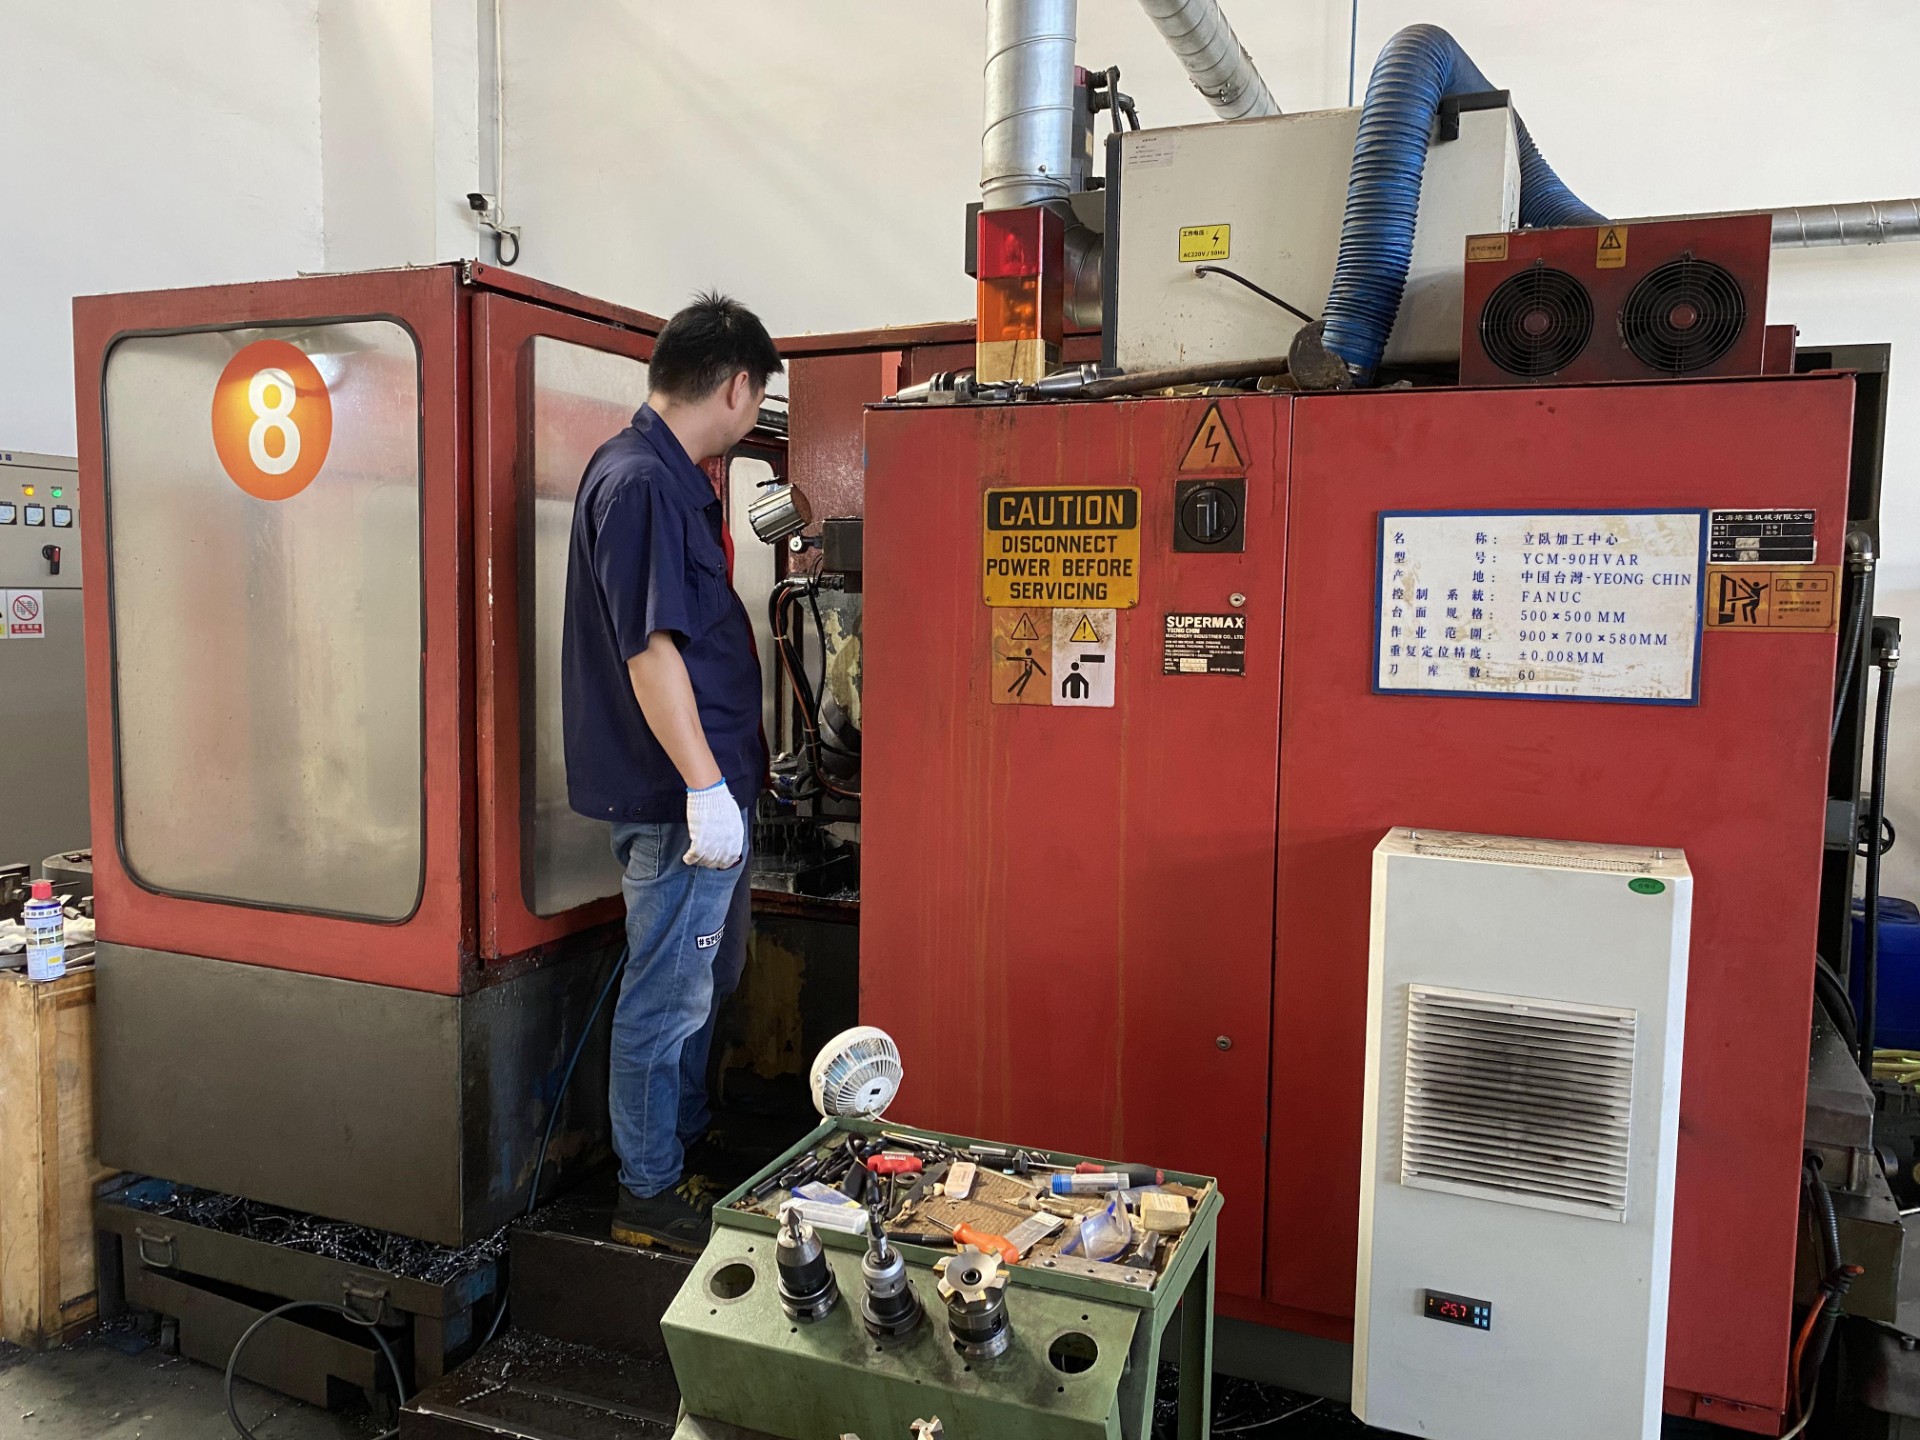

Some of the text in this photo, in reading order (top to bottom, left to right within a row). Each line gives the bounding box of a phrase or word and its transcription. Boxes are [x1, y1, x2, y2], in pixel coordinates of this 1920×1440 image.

[248, 367, 301, 475] 8
[999, 495, 1124, 526] CAUTION
[1002, 535, 1118, 553] DISCONNECT
[1523, 553, 1638, 566] YCM-90HVAR
[986, 558, 1133, 577] POWER BEFORE
[1652, 573, 1692, 586] CHIN
[1010, 582, 1108, 600] SERVICING
[1522, 591, 1582, 603] FANUC
[1166, 616, 1244, 628] SUPERMAX
[1518, 670, 1536, 681] 60
[1441, 1302, 1467, 1317] 25.7
